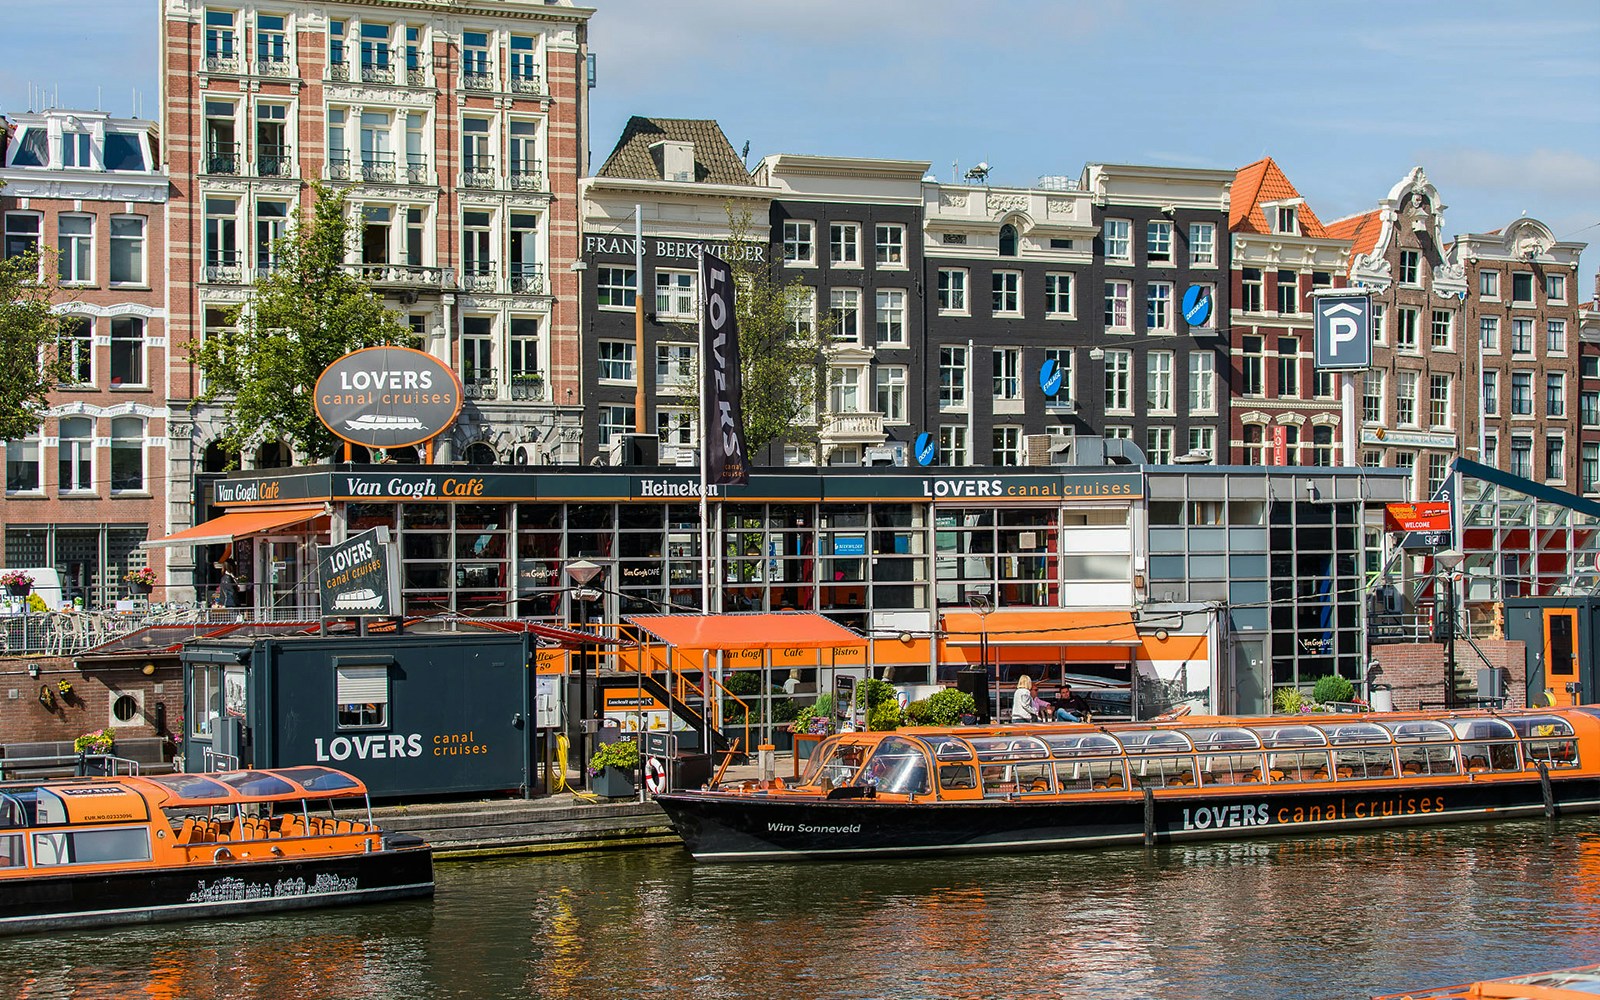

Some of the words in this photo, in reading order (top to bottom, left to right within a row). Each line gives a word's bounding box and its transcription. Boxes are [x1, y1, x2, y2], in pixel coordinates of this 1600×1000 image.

[586, 237, 646, 255] FRANS
[656, 241, 766, 262] BEEKWILDER
[1330, 317, 1358, 356] P
[709, 267, 741, 457] LOVERS
[341, 371, 432, 389] LOVERS
[322, 392, 372, 404] canal
[382, 391, 451, 404] cruises
[218, 485, 234, 501] Van
[235, 483, 257, 502] Gogh
[260, 481, 280, 499] Café
[347, 478, 381, 495] Van
[387, 478, 436, 499] Gogh
[442, 478, 484, 496] Café
[923, 480, 1003, 496] LOVERS
[1007, 482, 1058, 496] canal
[1063, 482, 1131, 495] cruises
[330, 540, 373, 573] LOVERS
[326, 570, 350, 589] canal
[351, 559, 381, 579] cruises
[633, 568, 648, 578] Gogh
[834, 648, 859, 656] Bistro
[314, 734, 423, 762] LOVERS
[433, 731, 474, 744] canal
[433, 744, 488, 756] cruises
[1183, 803, 1270, 830] LOVERS
[1277, 798, 1347, 823] canal
[1355, 795, 1445, 819] cruises
[768, 822, 795, 832] Wim
[797, 823, 861, 833] Sonneveld
